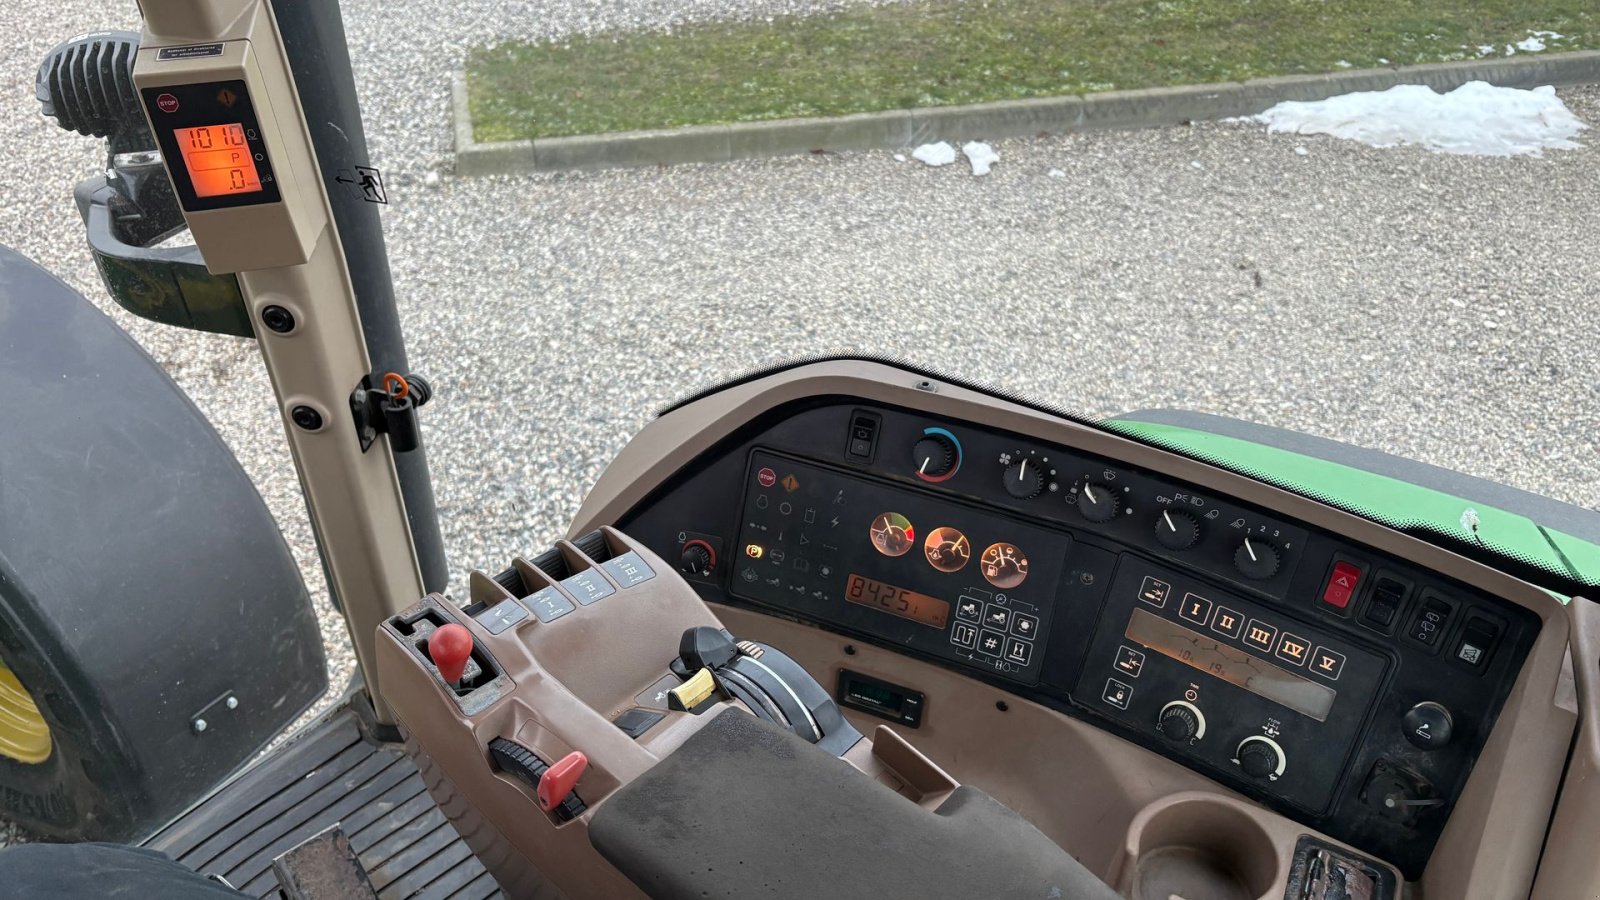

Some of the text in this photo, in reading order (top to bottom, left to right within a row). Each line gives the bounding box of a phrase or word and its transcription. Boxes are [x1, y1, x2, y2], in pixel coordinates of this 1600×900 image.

[190, 125, 244, 149] 1010
[231, 152, 240, 163] P
[760, 473, 774, 481] STOP
[1156, 495, 1172, 505] OFF
[1191, 603, 1201, 616] I
[1219, 614, 1235, 630] II
[1249, 626, 1271, 645] III
[1282, 640, 1305, 659] IV
[1319, 655, 1336, 671] V
